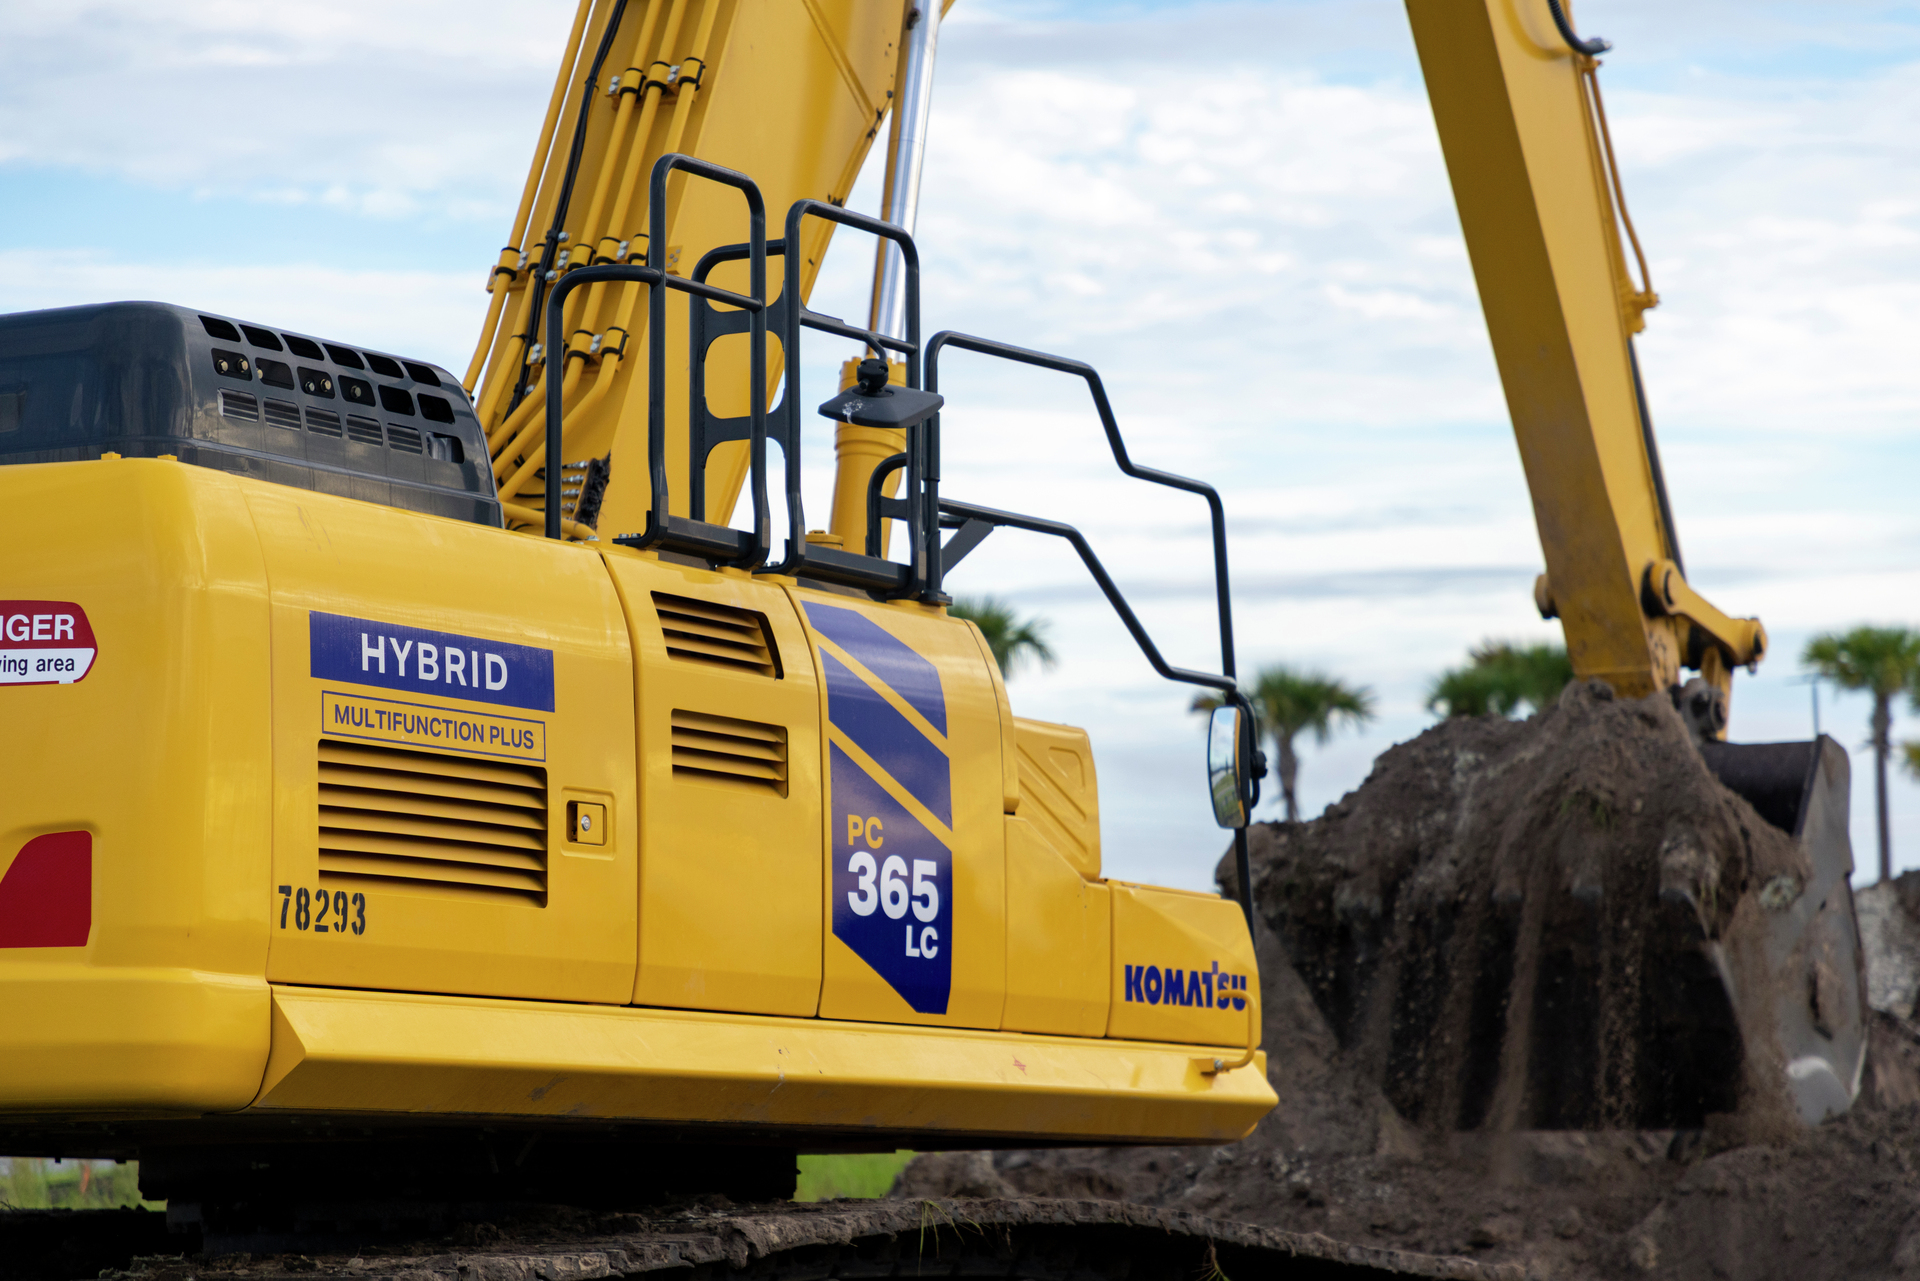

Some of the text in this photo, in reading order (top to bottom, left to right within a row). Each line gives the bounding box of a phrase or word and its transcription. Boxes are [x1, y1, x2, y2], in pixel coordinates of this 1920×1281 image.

[0, 614, 75, 642] GER
[0, 655, 75, 676] ing area
[361, 632, 508, 691] HYBRID
[334, 703, 534, 750] MULTIFUNCTION PLUS
[847, 814, 884, 849] PC
[278, 885, 366, 936] 78293
[847, 851, 939, 923] 365
[905, 924, 938, 959] LC
[1124, 960, 1247, 1012] KOMATSU
